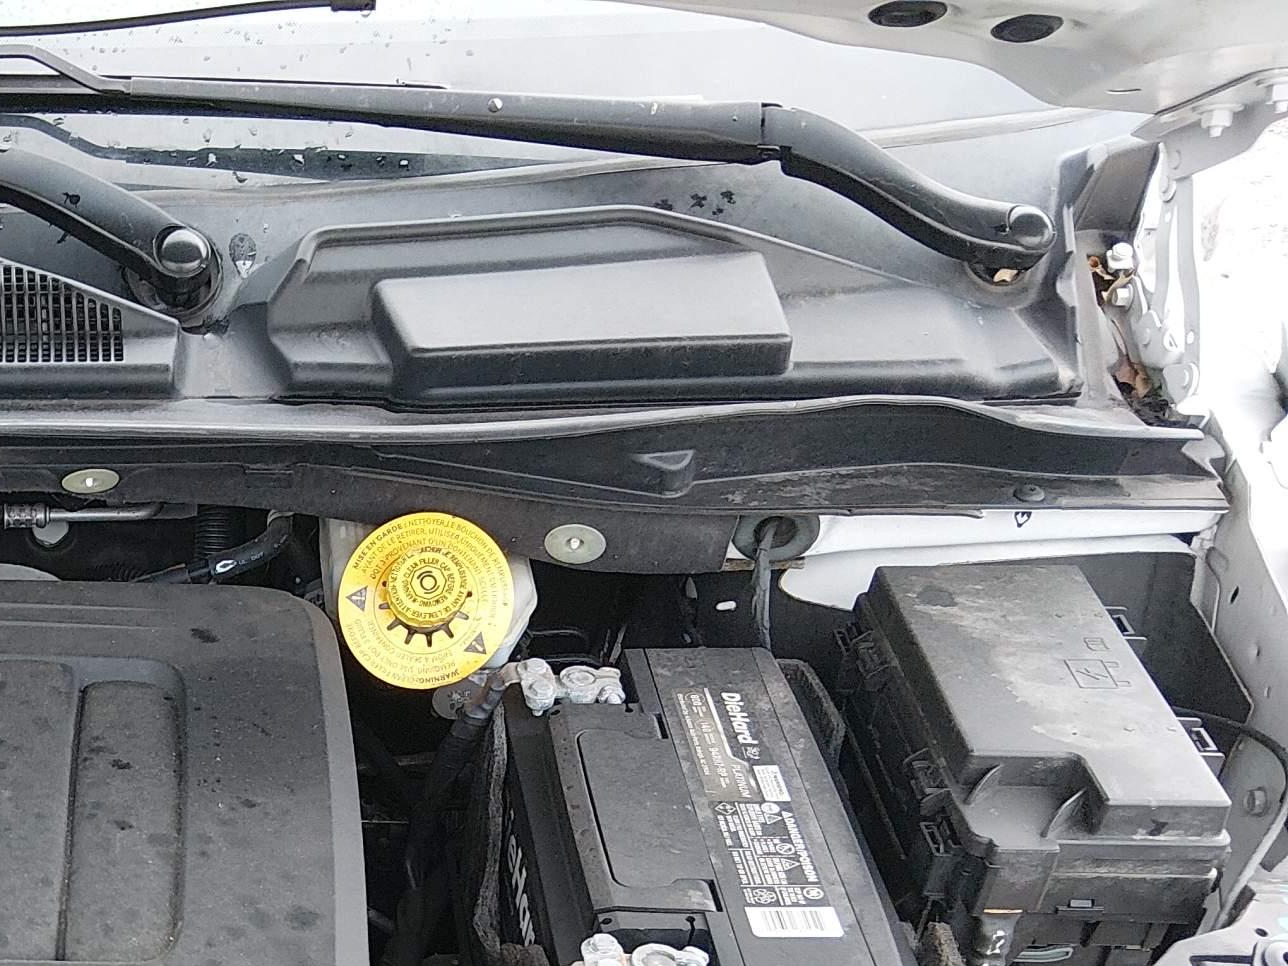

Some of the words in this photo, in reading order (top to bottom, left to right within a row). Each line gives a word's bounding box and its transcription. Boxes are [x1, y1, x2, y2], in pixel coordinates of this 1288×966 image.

[352, 549, 368, 569] MISE
[721, 692, 759, 745] DieHard
[731, 764, 752, 798] PLATINUM
[786, 817, 820, 882] DANGER/POISON
